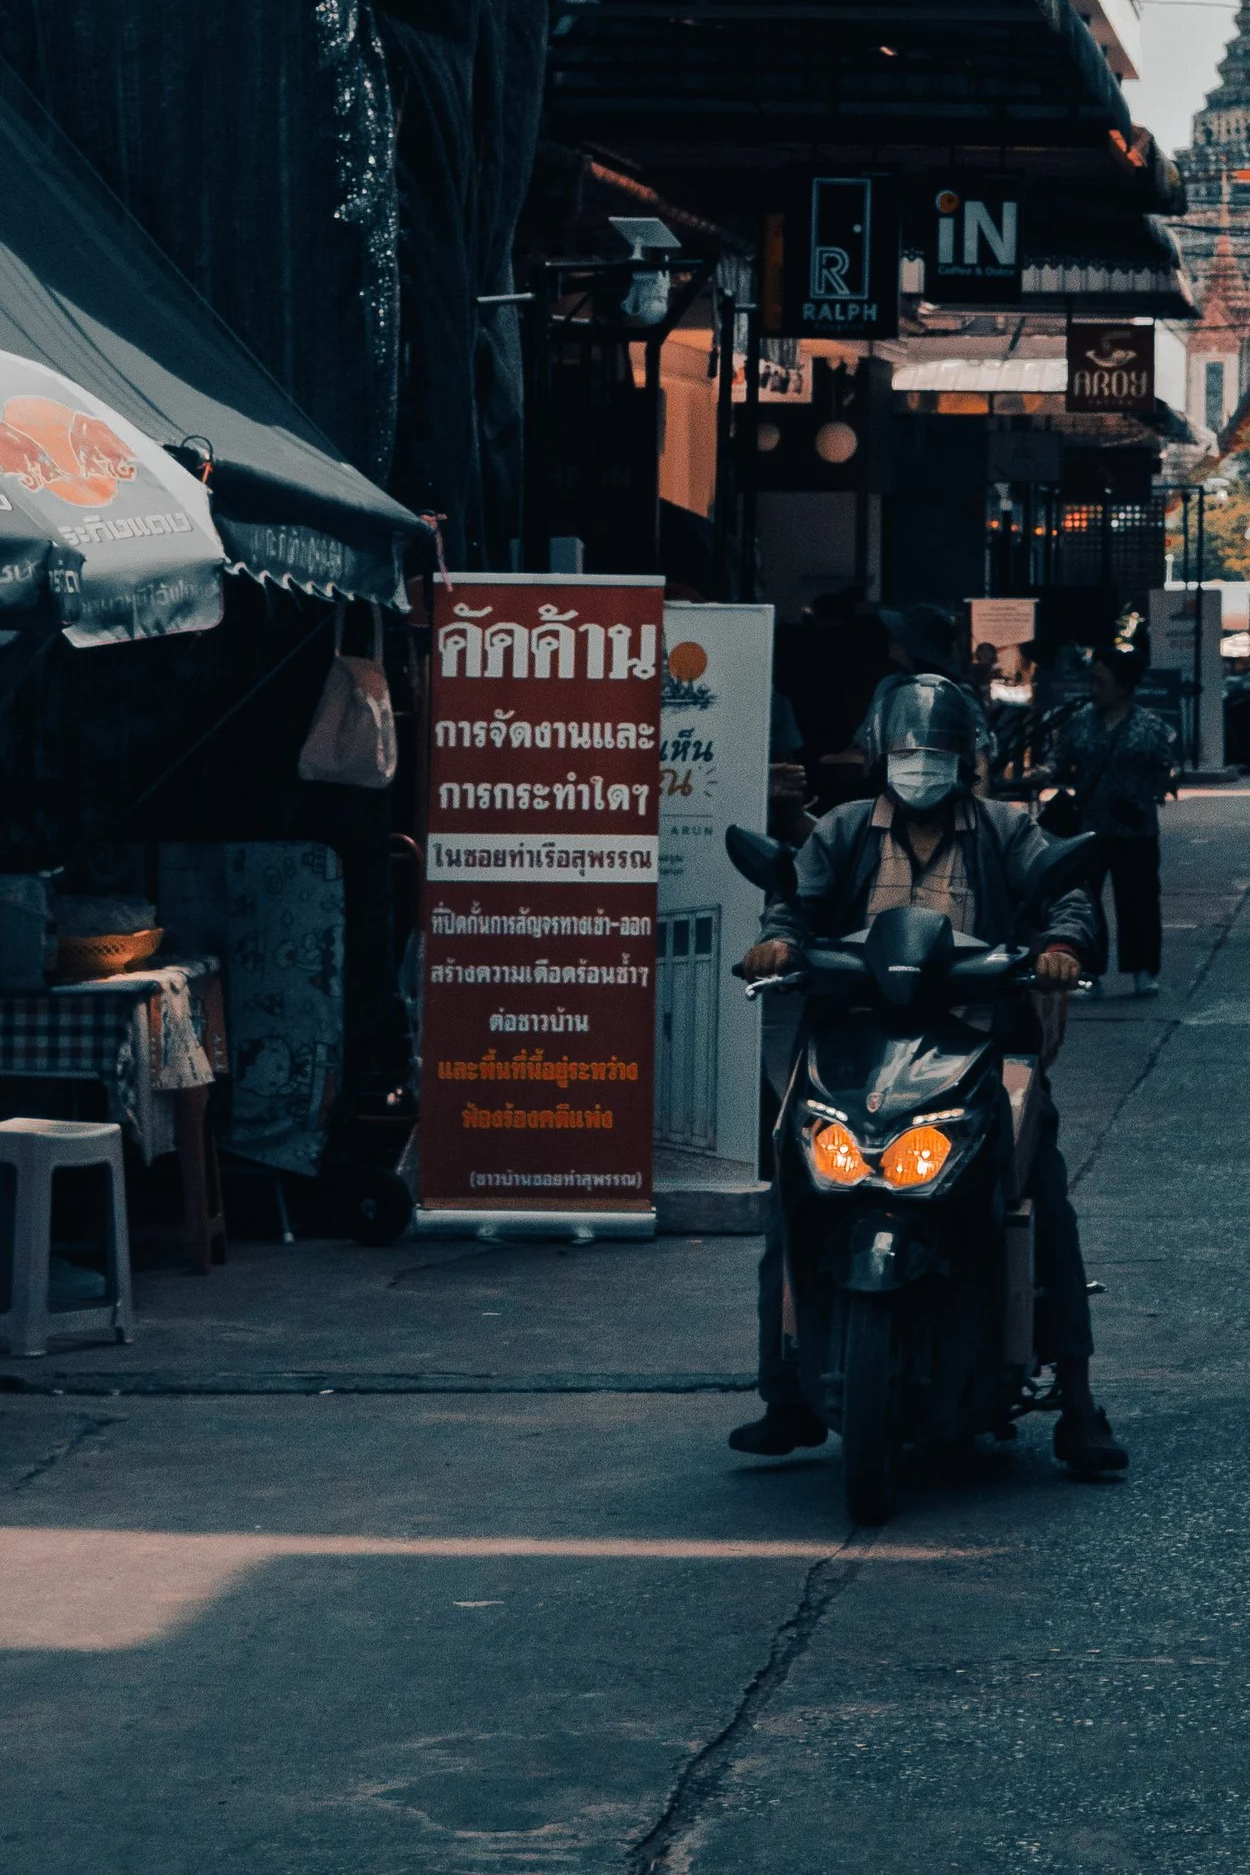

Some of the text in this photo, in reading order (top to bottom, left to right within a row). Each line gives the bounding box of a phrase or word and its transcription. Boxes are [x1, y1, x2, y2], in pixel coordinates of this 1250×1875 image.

[802, 303, 878, 321] RALPH
[437, 603, 657, 679] คัดค้าน
[435, 709, 655, 750] การจัดงานและ
[439, 771, 649, 815] การกระทำใดๆ
